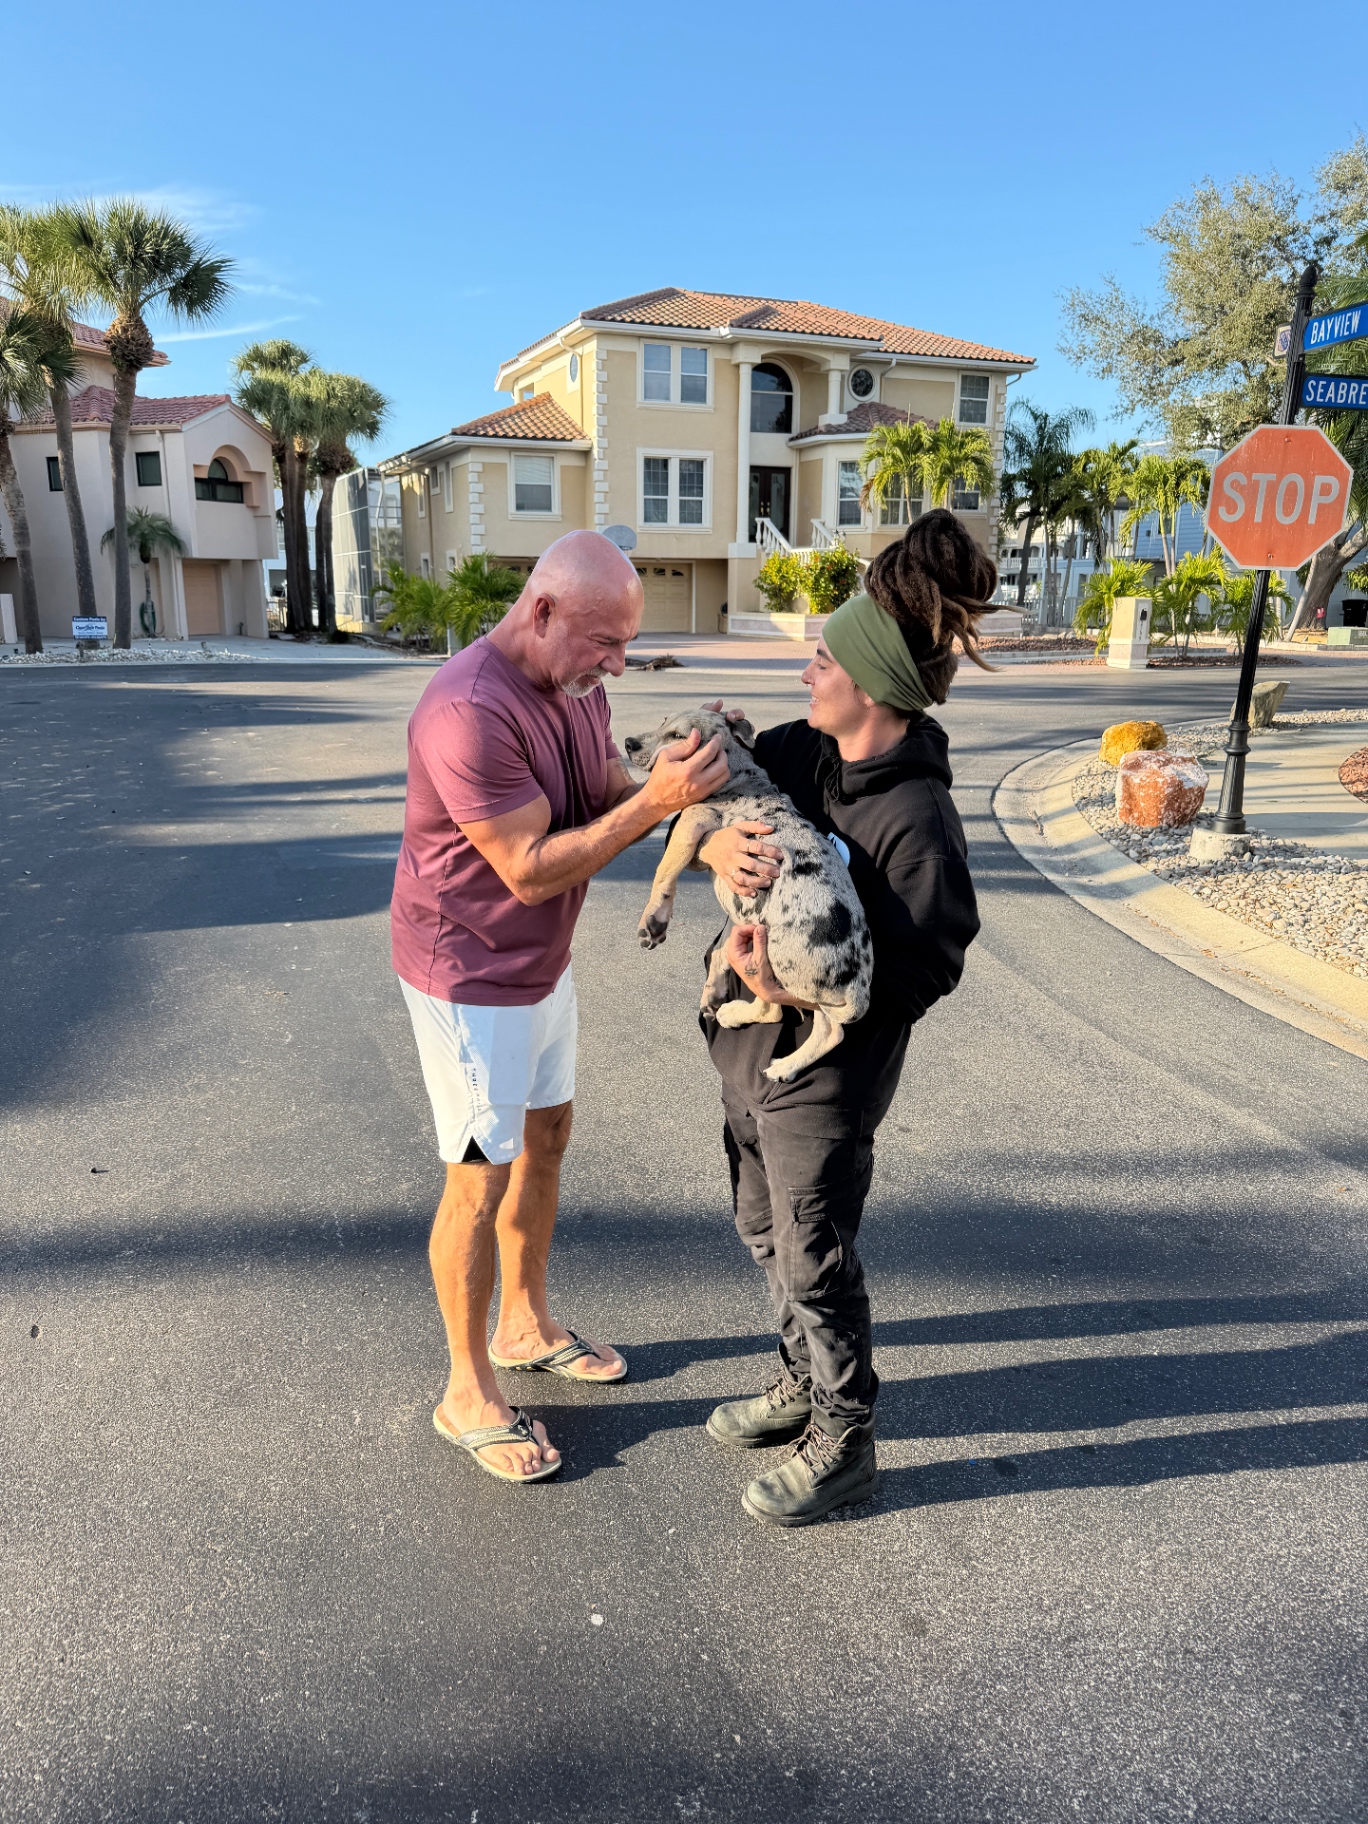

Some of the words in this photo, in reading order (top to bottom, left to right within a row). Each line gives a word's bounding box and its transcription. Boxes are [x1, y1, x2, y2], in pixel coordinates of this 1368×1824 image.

[1310, 310, 1361, 345] BAYVIEW
[1306, 379, 1368, 405] SEABRE
[1218, 472, 1340, 525] STOP
